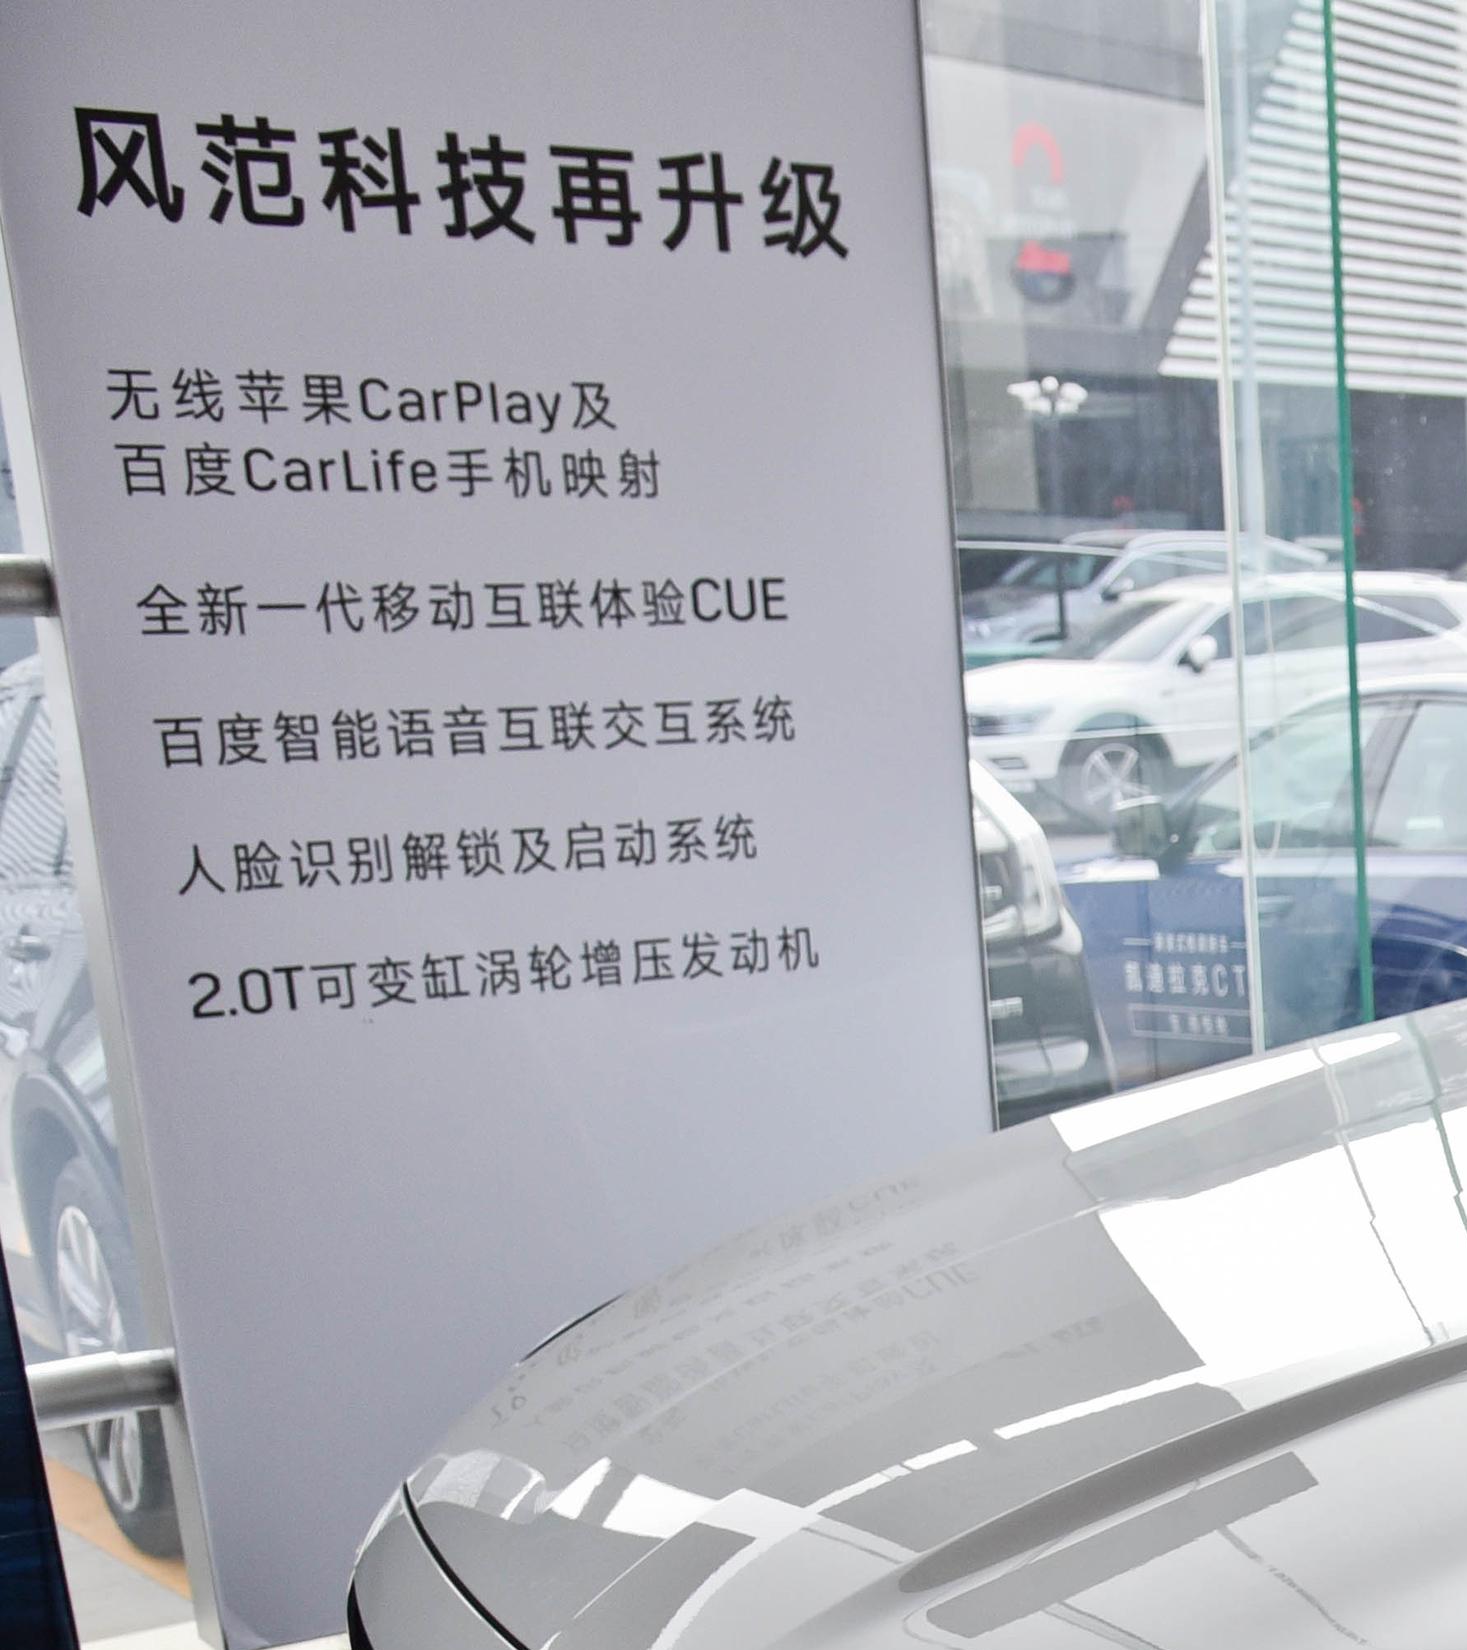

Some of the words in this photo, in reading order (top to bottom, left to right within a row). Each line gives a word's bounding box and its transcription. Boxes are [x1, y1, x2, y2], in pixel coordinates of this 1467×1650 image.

[74, 107, 848, 259] 风范科技再升级
[107, 368, 616, 433] 无线苹果CarPlay及
[114, 442, 659, 498] 百度CarLife手机映射
[137, 578, 788, 636] 全新一代移动互联体验CUE
[153, 695, 795, 768] 百度智能语音互联交互系统
[179, 813, 757, 895] 人脸识别解锁及启动系统
[188, 926, 819, 1019] 2.0T可变缸涡轮增压发动机
